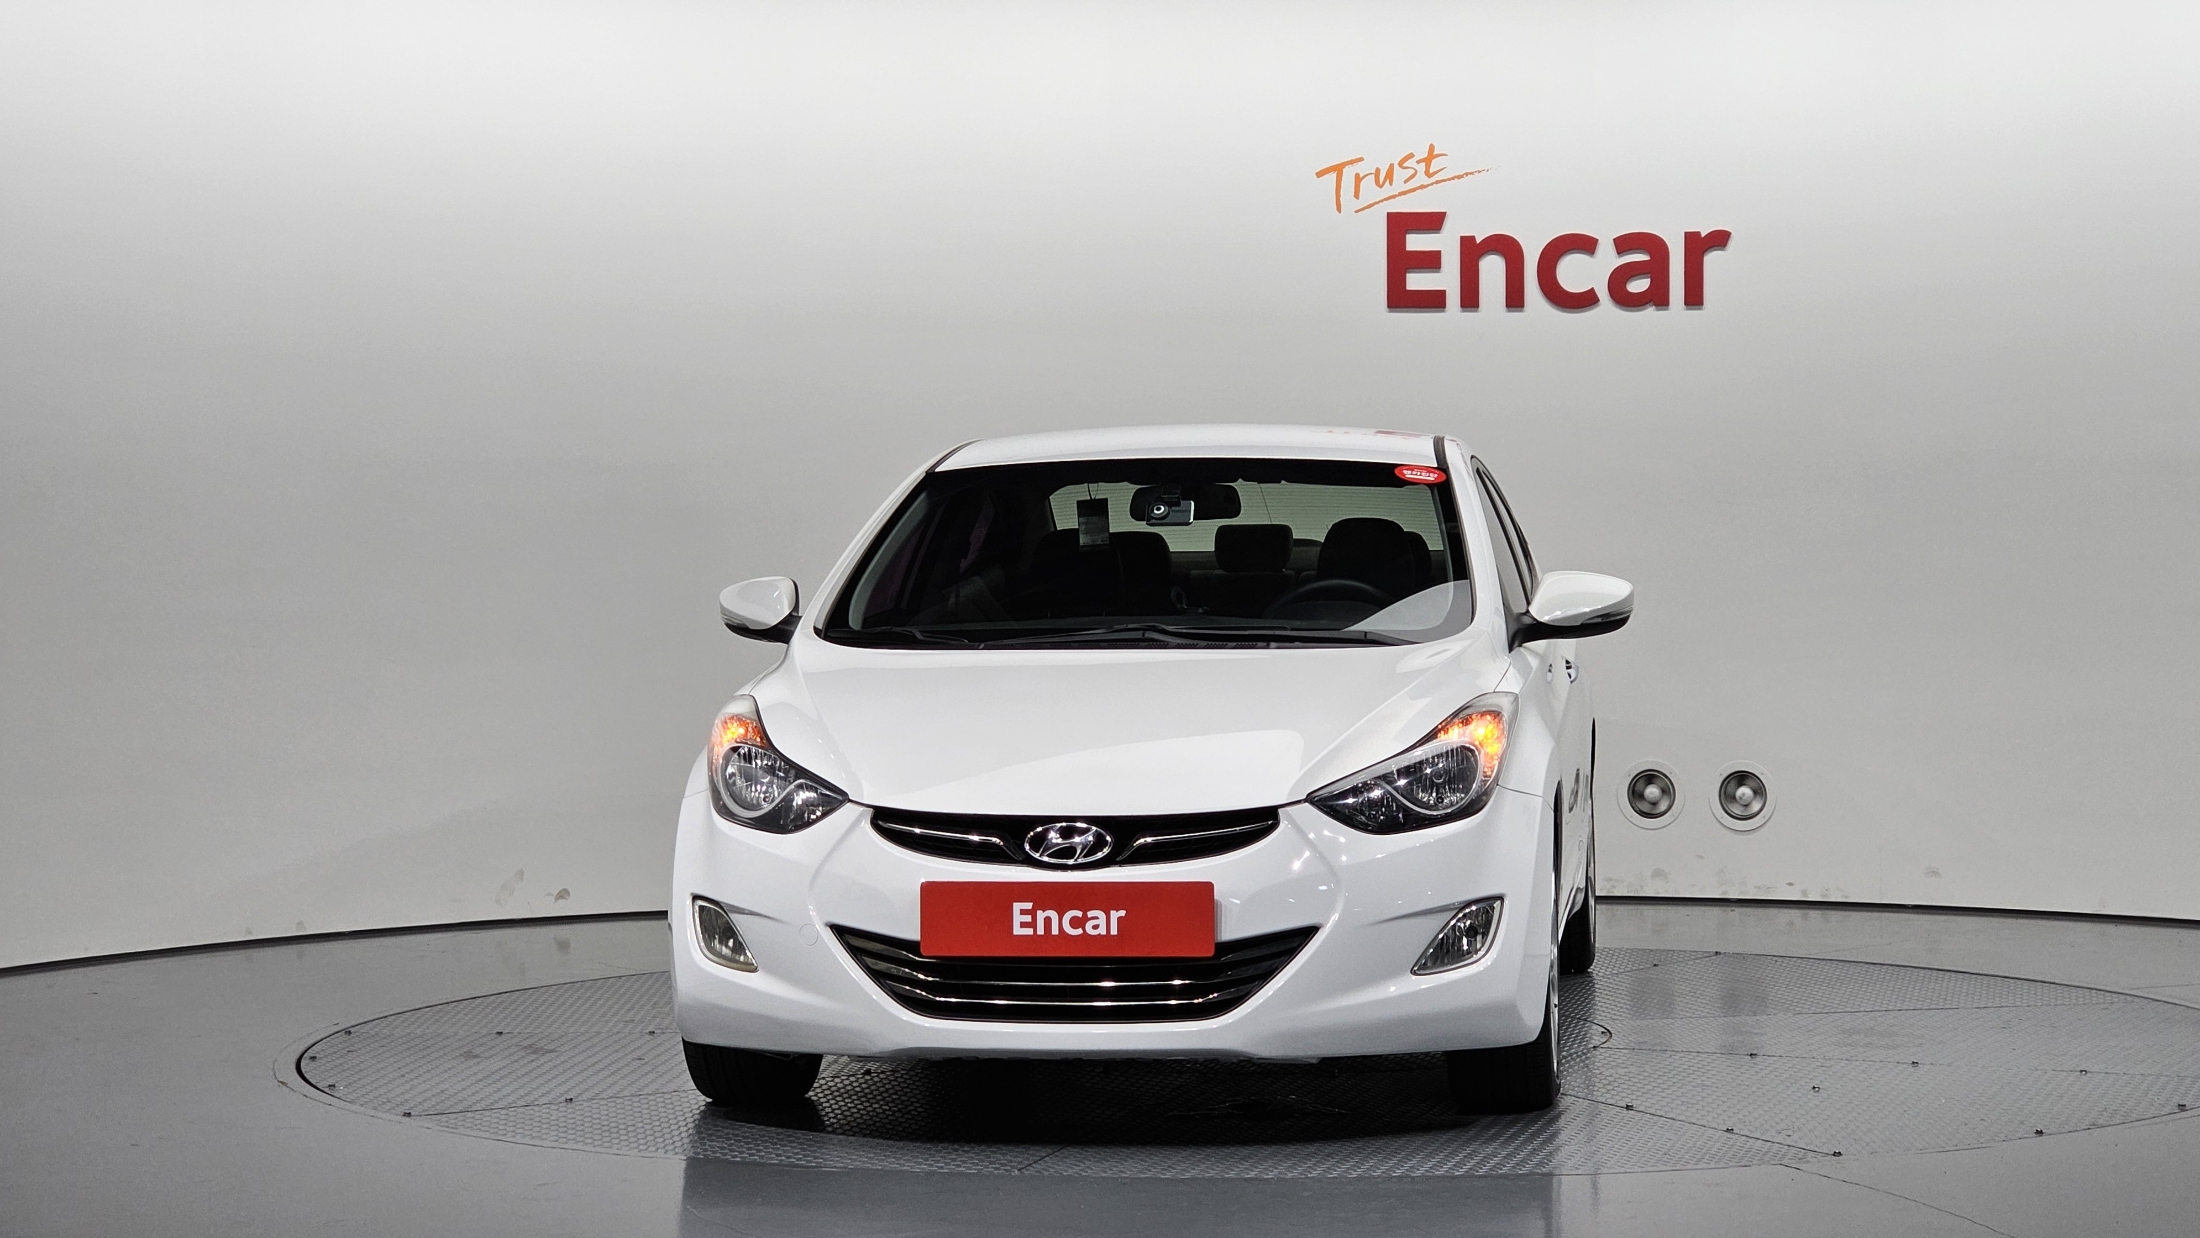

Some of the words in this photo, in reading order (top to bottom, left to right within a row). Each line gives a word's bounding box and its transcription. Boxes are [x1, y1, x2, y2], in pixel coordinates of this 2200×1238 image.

[1315, 143, 1450, 214] Trust
[1385, 211, 1732, 311] Encar
[1011, 901, 1127, 936] Encar
